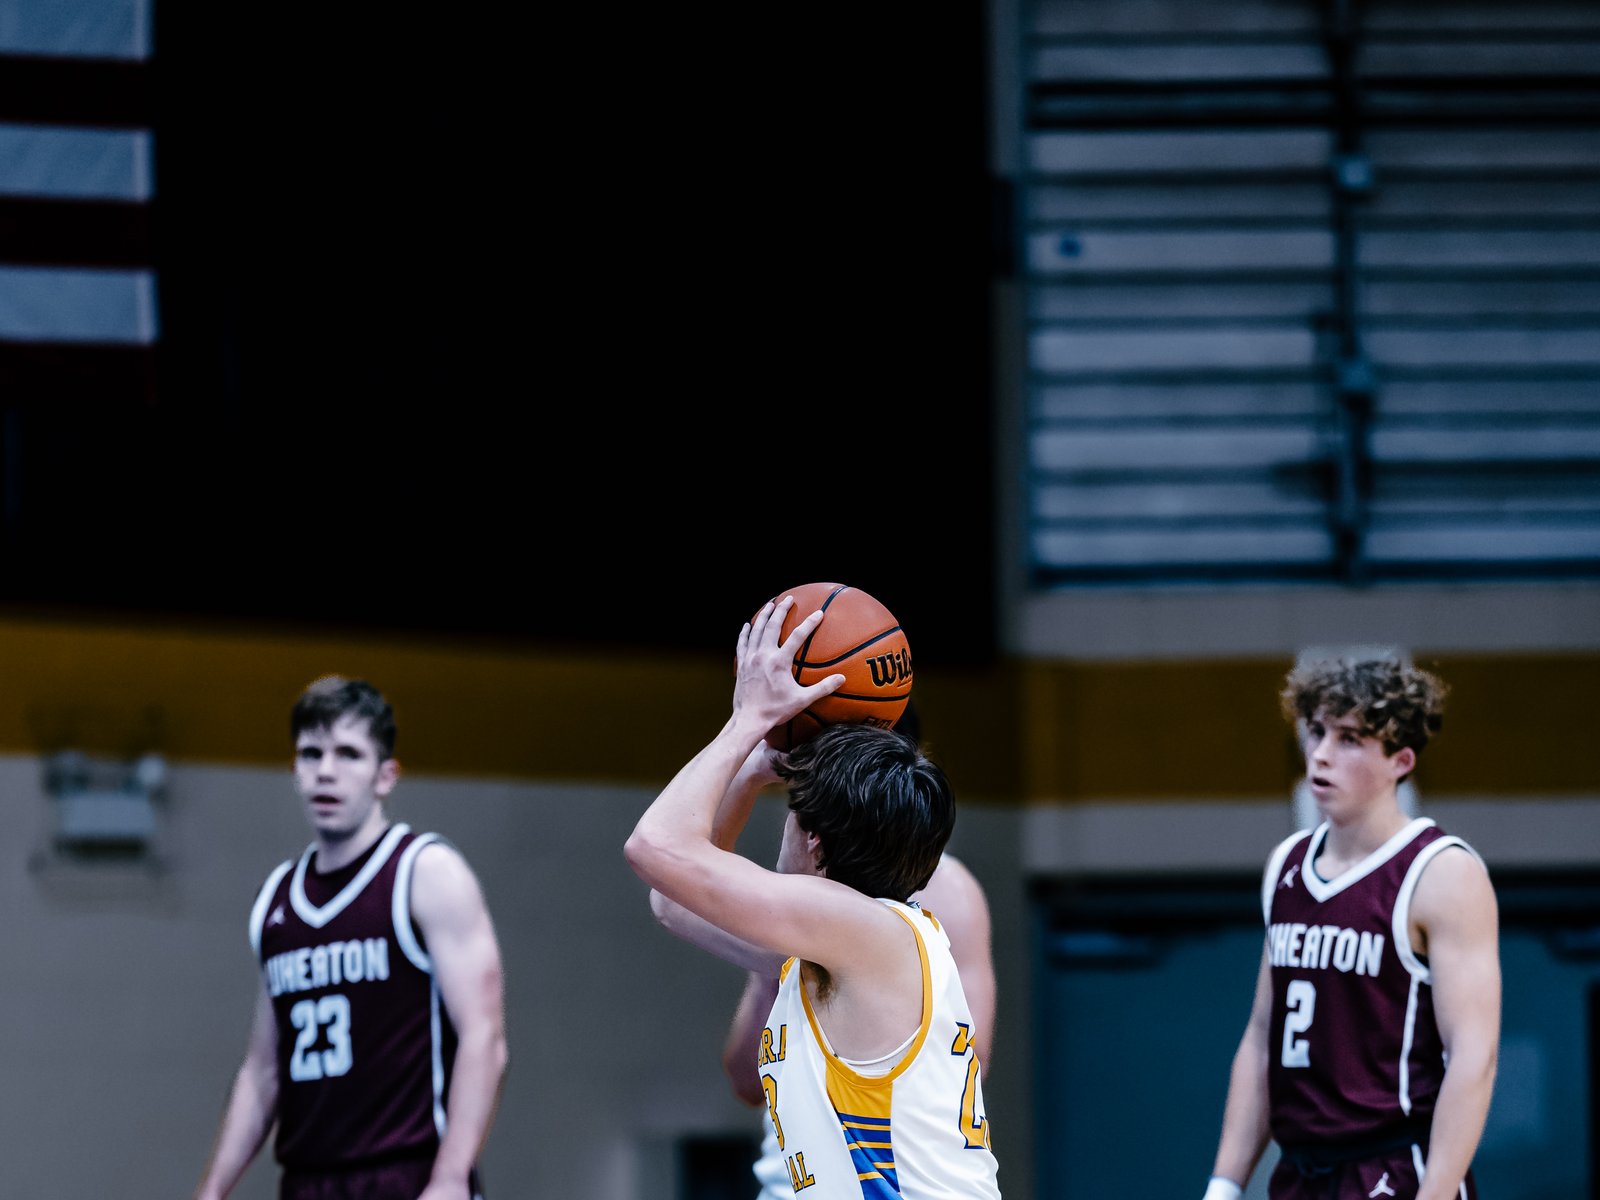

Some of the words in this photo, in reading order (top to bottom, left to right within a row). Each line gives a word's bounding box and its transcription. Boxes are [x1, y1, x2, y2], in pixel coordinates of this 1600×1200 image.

[866, 648, 911, 687] Wil
[290, 994, 353, 1081] 23
[1281, 980, 1316, 1067] 2
